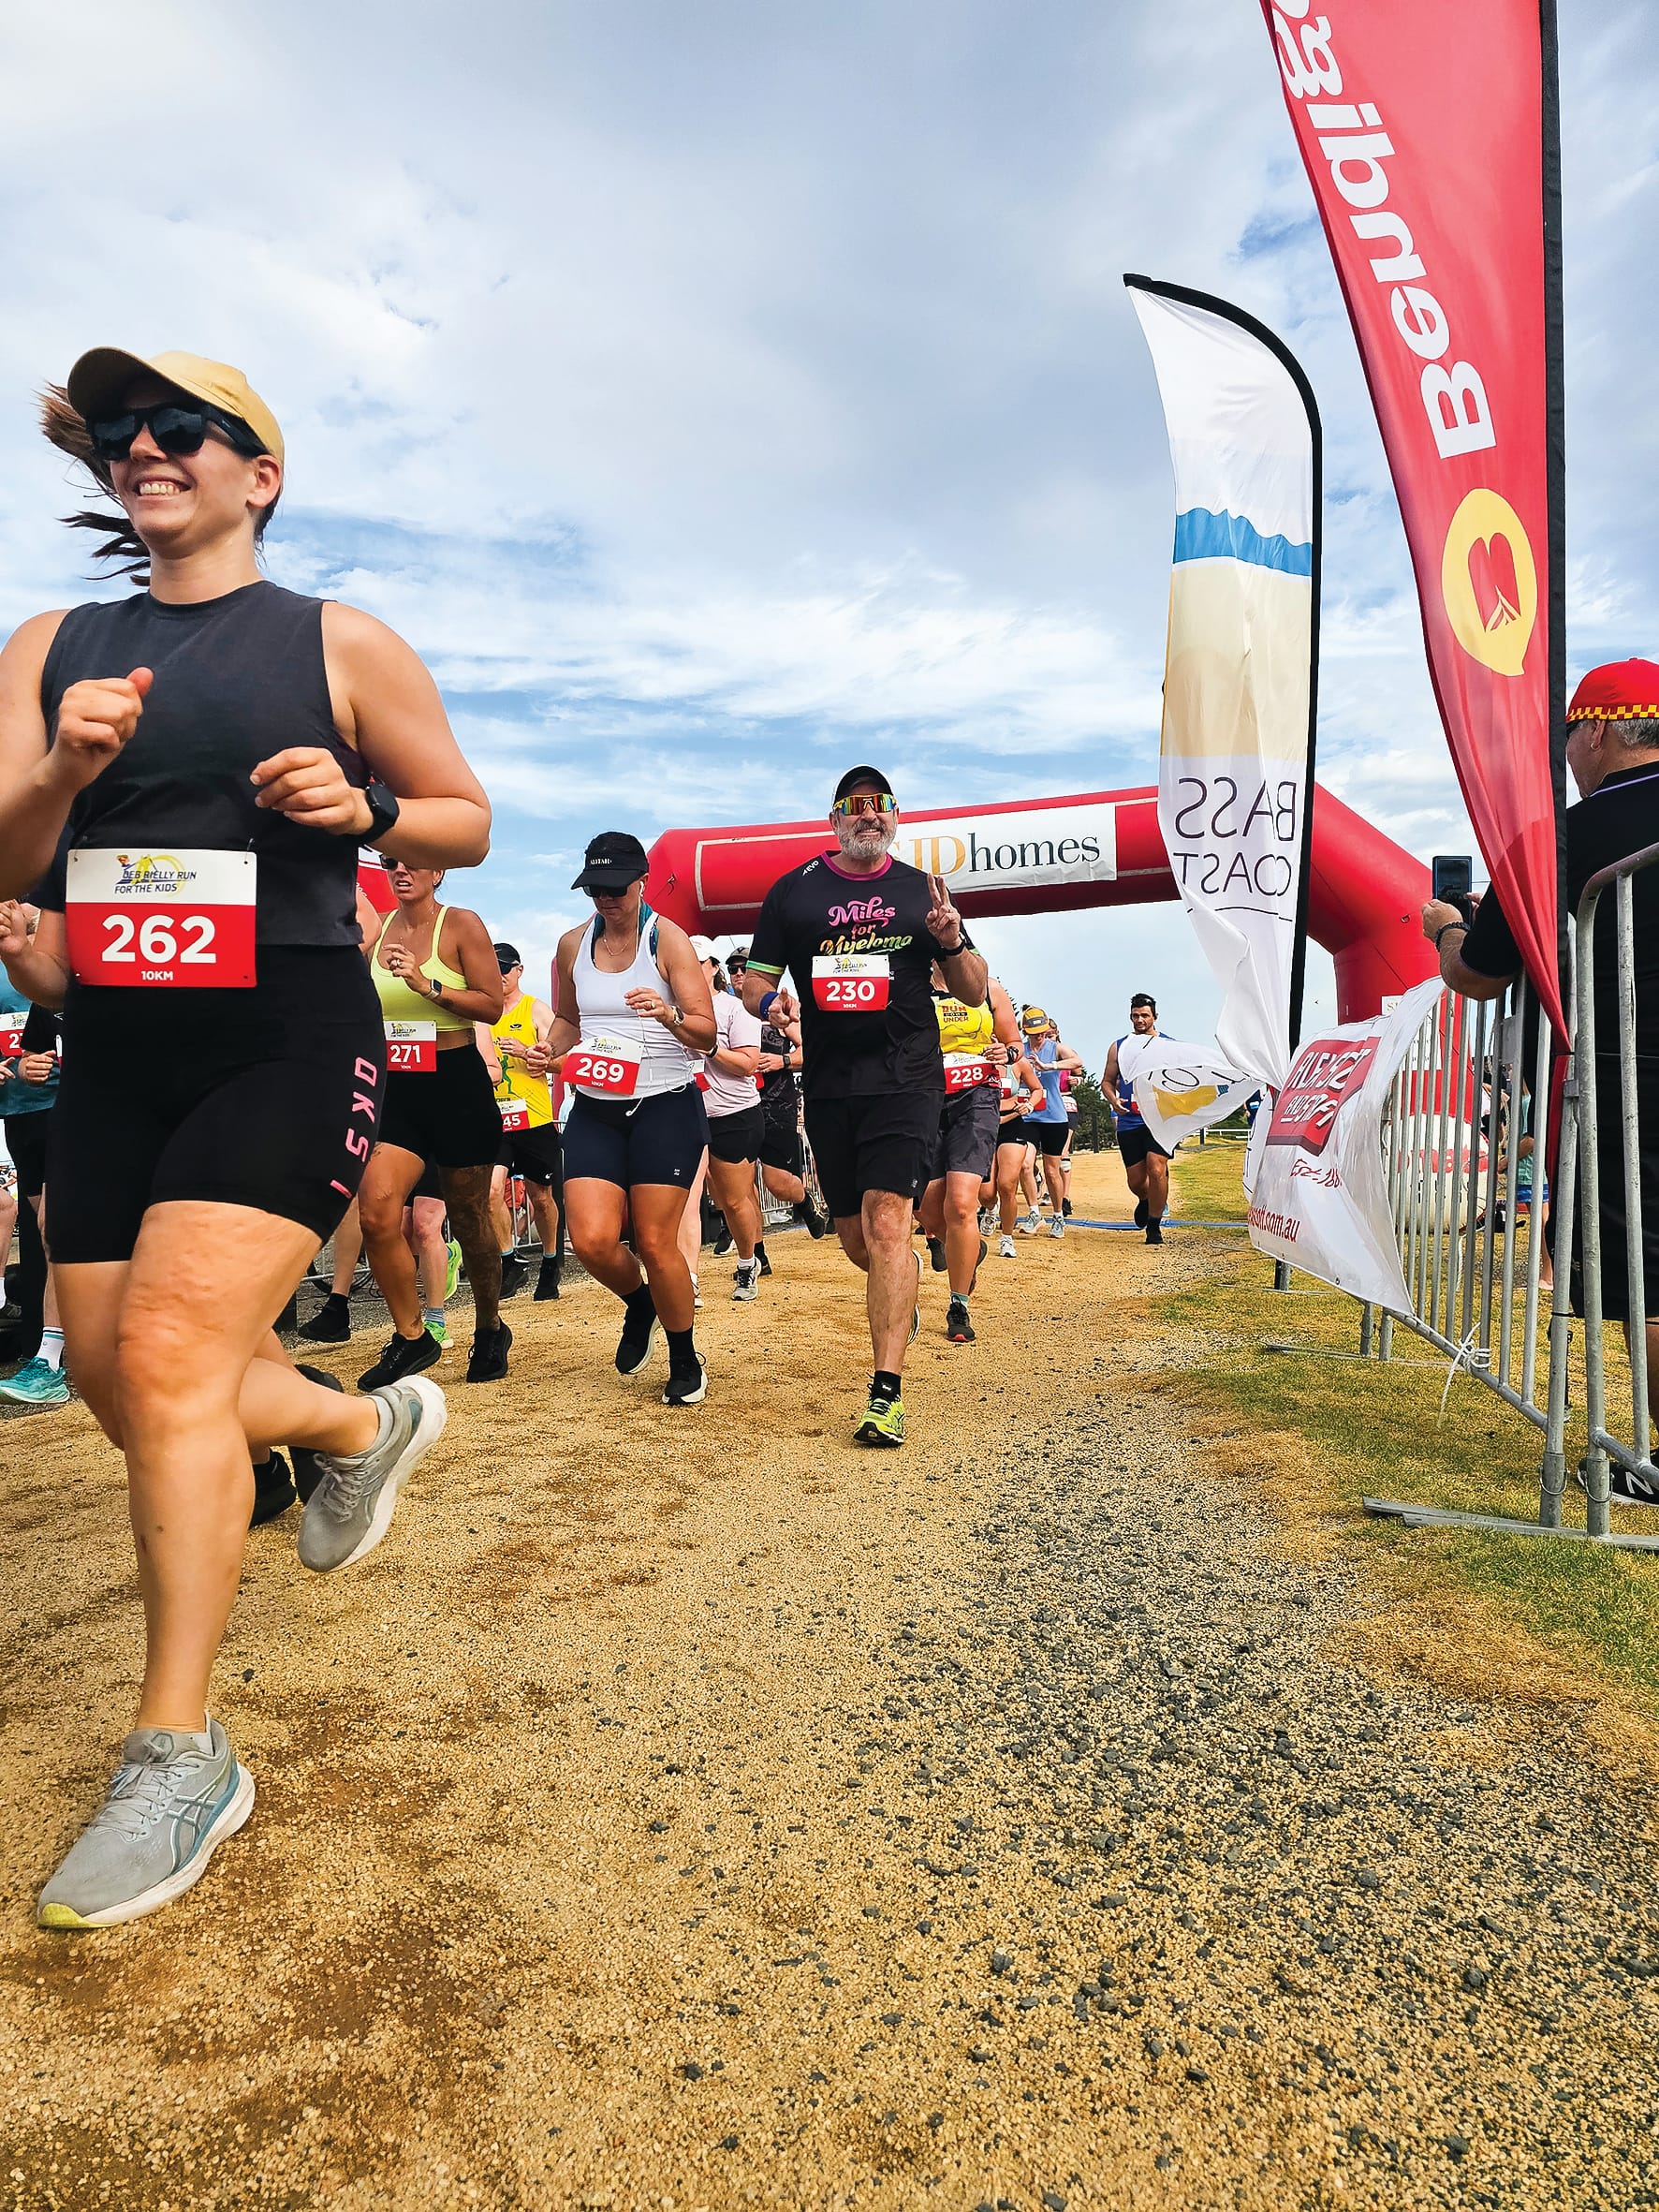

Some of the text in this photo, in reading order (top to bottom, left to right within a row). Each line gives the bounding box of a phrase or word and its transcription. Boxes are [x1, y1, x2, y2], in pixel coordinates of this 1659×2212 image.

[177, 871, 197, 879] RUN
[114, 883, 178, 894] FOR THE KIDS
[828, 896, 896, 927] Miles
[101, 914, 217, 964] 262
[851, 923, 876, 939] for
[819, 932, 914, 955] Myeloma
[140, 970, 173, 981] 10KM
[826, 981, 875, 1002] 230
[389, 1044, 421, 1063] 271
[576, 1056, 624, 1083] 269
[950, 1067, 984, 1084] 228
